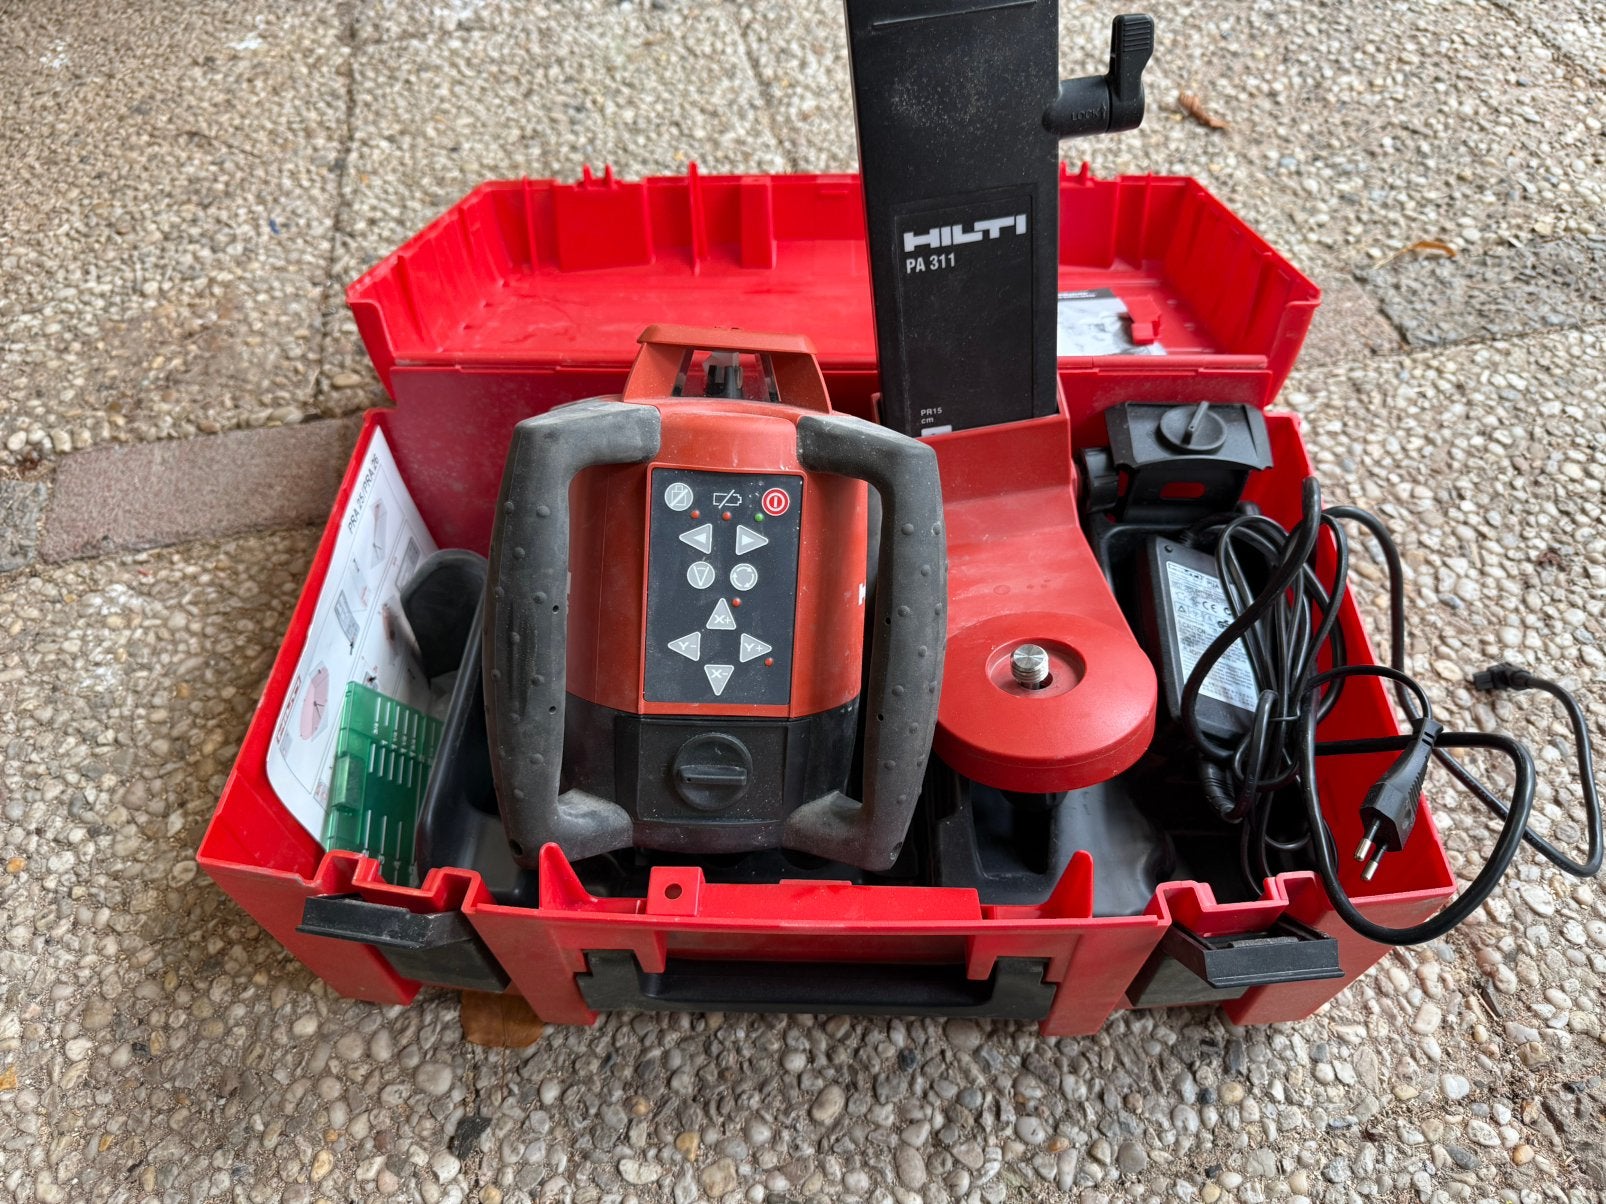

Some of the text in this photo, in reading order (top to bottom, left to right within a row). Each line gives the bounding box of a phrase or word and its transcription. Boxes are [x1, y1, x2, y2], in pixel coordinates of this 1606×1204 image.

[1071, 107, 1100, 121] LOCK
[903, 214, 1027, 253] HILTI
[906, 252, 955, 274] PA 311
[921, 417, 934, 425] cm
[348, 508, 360, 535] PRA
[714, 614, 732, 625] X+
